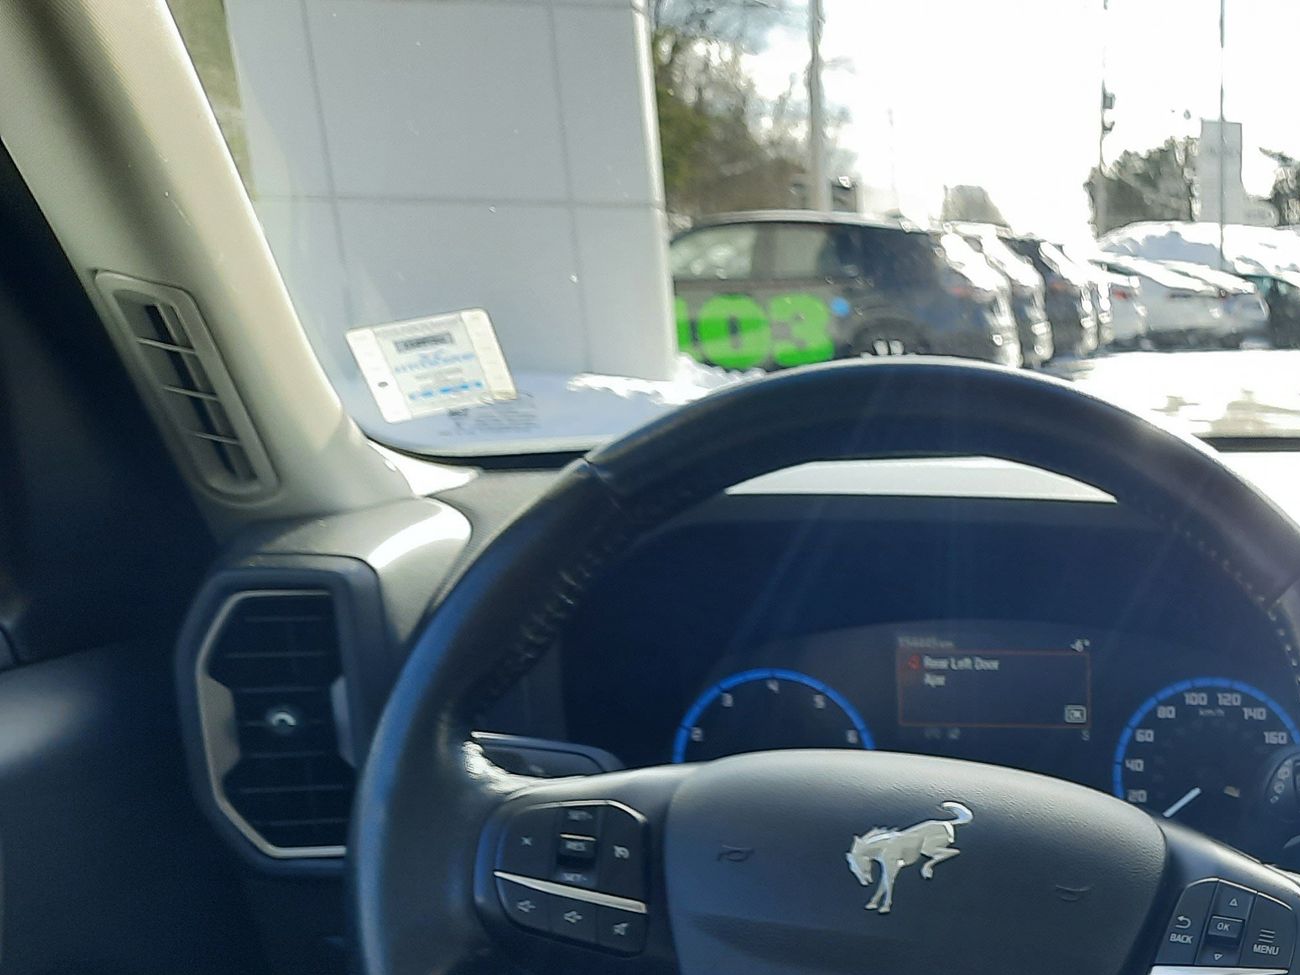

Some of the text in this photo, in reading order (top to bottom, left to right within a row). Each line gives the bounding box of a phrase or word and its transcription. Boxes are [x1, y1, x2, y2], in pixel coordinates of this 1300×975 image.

[1184, 692, 1208, 706] 100
[1217, 693, 1241, 707] 120
[1156, 706, 1176, 719] 80
[1242, 707, 1267, 721] 140
[1135, 729, 1154, 742] 60
[1263, 731, 1288, 745] 160
[1125, 758, 1144, 772] 40
[1127, 789, 1147, 802] 20
[1217, 922, 1230, 932] OK
[1169, 933, 1194, 945] BACK
[1253, 944, 1280, 956] MENU
